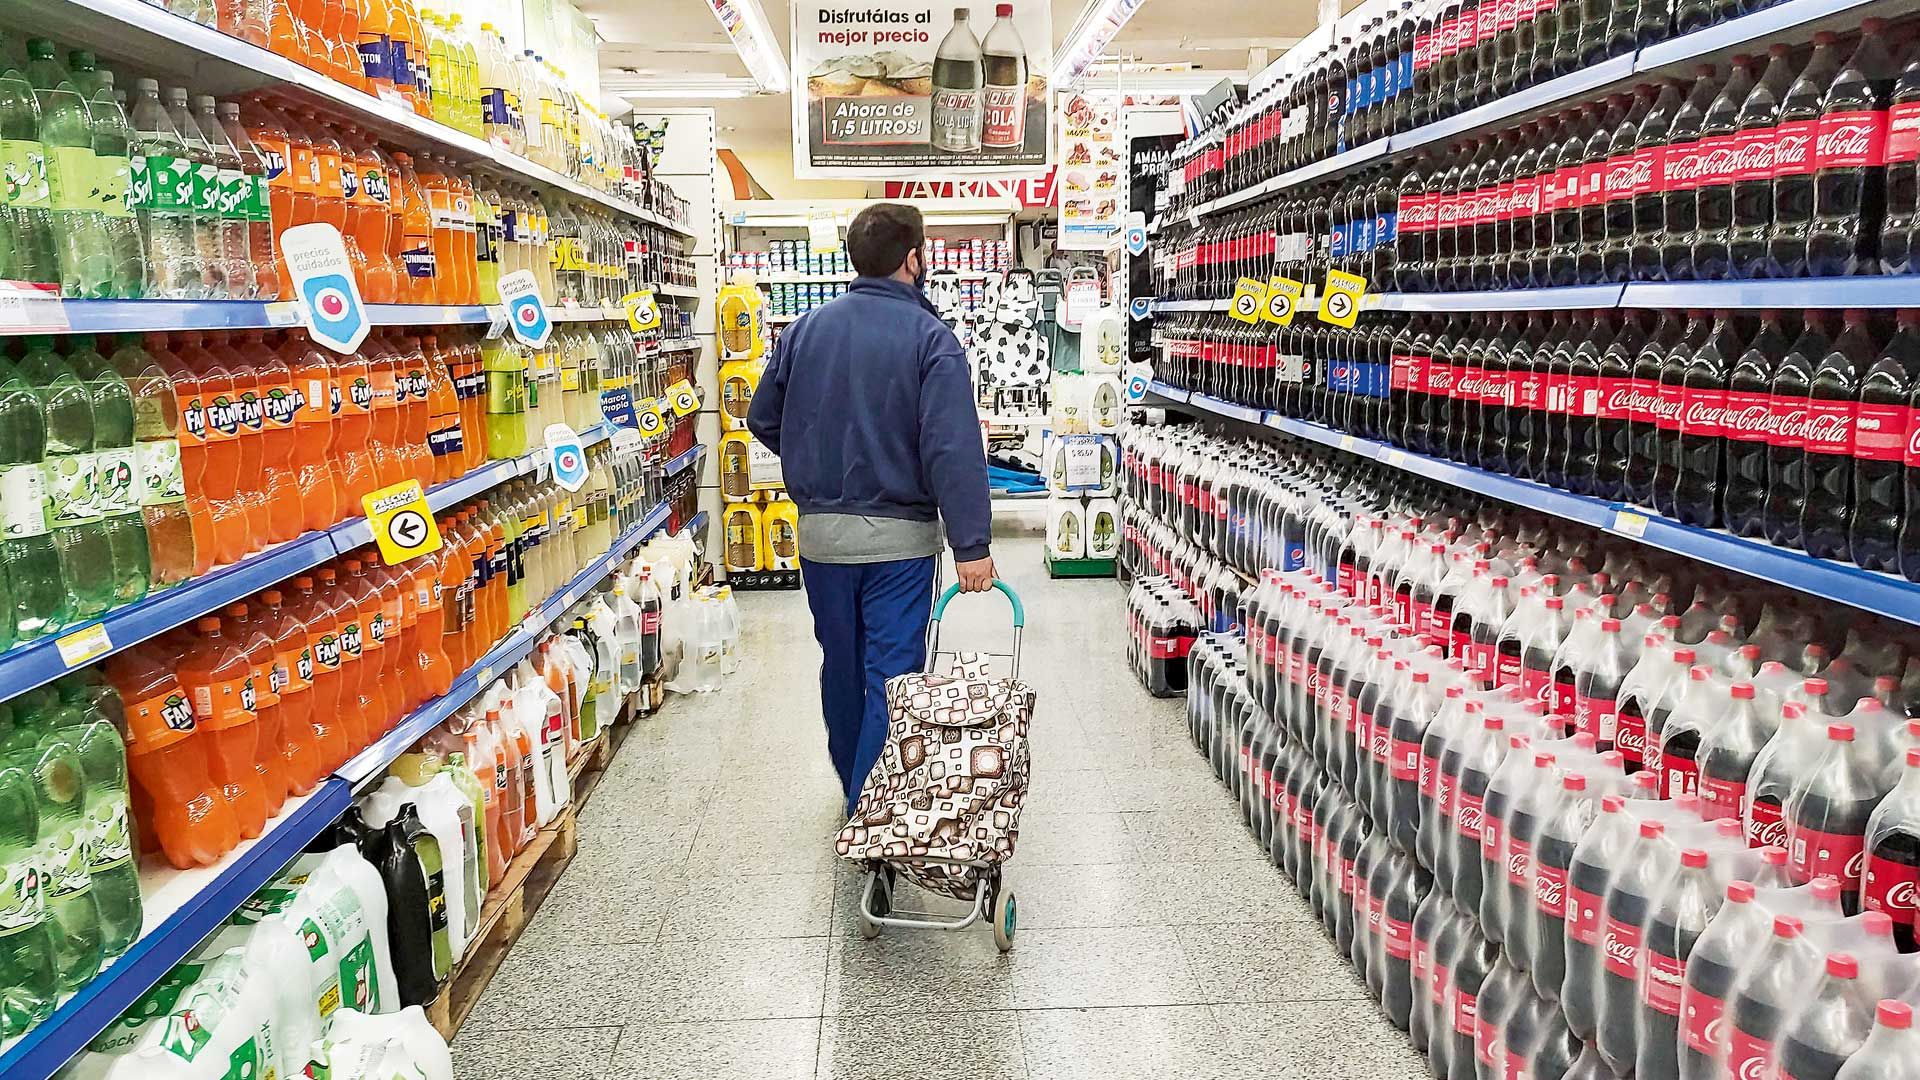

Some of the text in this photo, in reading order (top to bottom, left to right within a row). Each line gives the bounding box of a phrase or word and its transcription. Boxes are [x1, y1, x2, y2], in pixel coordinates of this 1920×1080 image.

[819, 8, 931, 24] Disfrutálas al
[819, 28, 929, 46] mejor precio
[835, 102, 915, 117] Ahora de
[984, 108, 1015, 127] COLA
[831, 119, 922, 137] 1,5 LITROS!
[292, 247, 330, 262] precios
[296, 257, 342, 273] cuidados
[601, 393, 627, 405] Marca
[602, 401, 629, 413] Propia
